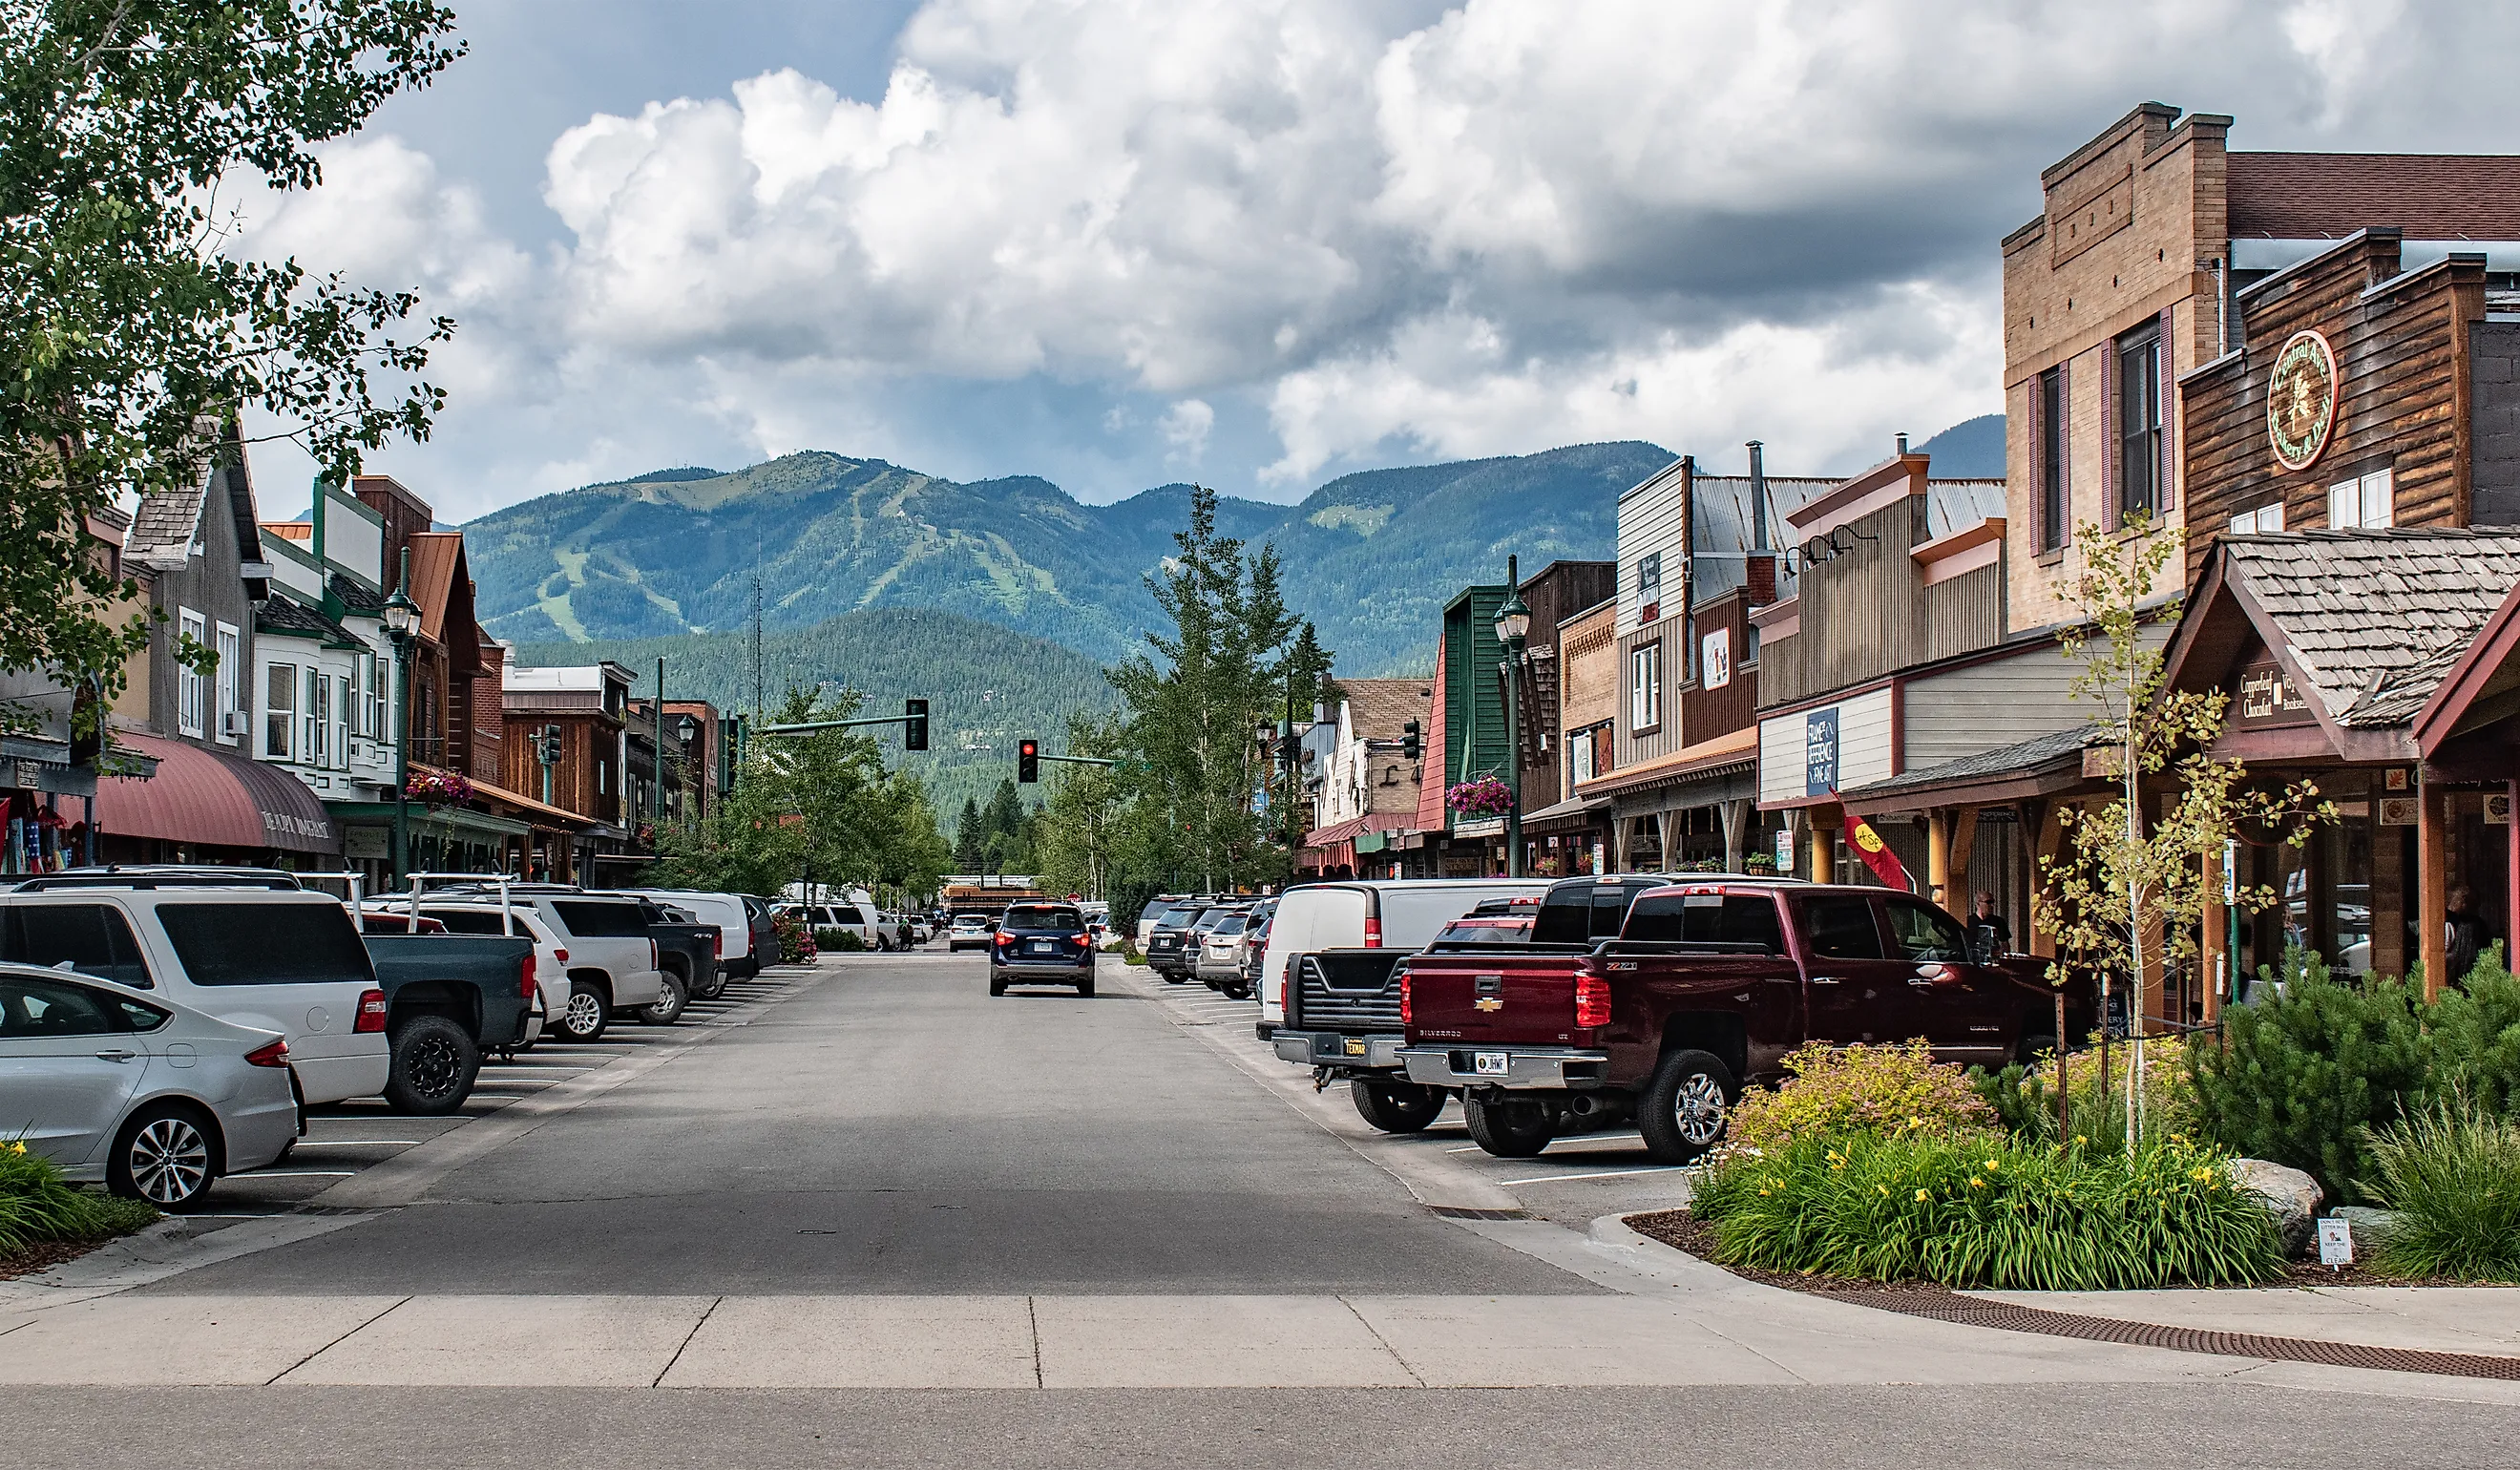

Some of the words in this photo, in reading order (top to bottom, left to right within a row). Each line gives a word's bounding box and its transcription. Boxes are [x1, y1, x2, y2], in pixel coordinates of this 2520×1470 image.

[2275, 340, 2308, 390] Central
[2310, 344, 2327, 384] Ave.
[2272, 408, 2301, 462] Bakery
[2304, 435, 2313, 455] &
[2240, 671, 2273, 698] Copperleaf
[2243, 698, 2273, 718] Chocolat
[1419, 1029, 1461, 1038] SILVERADO
